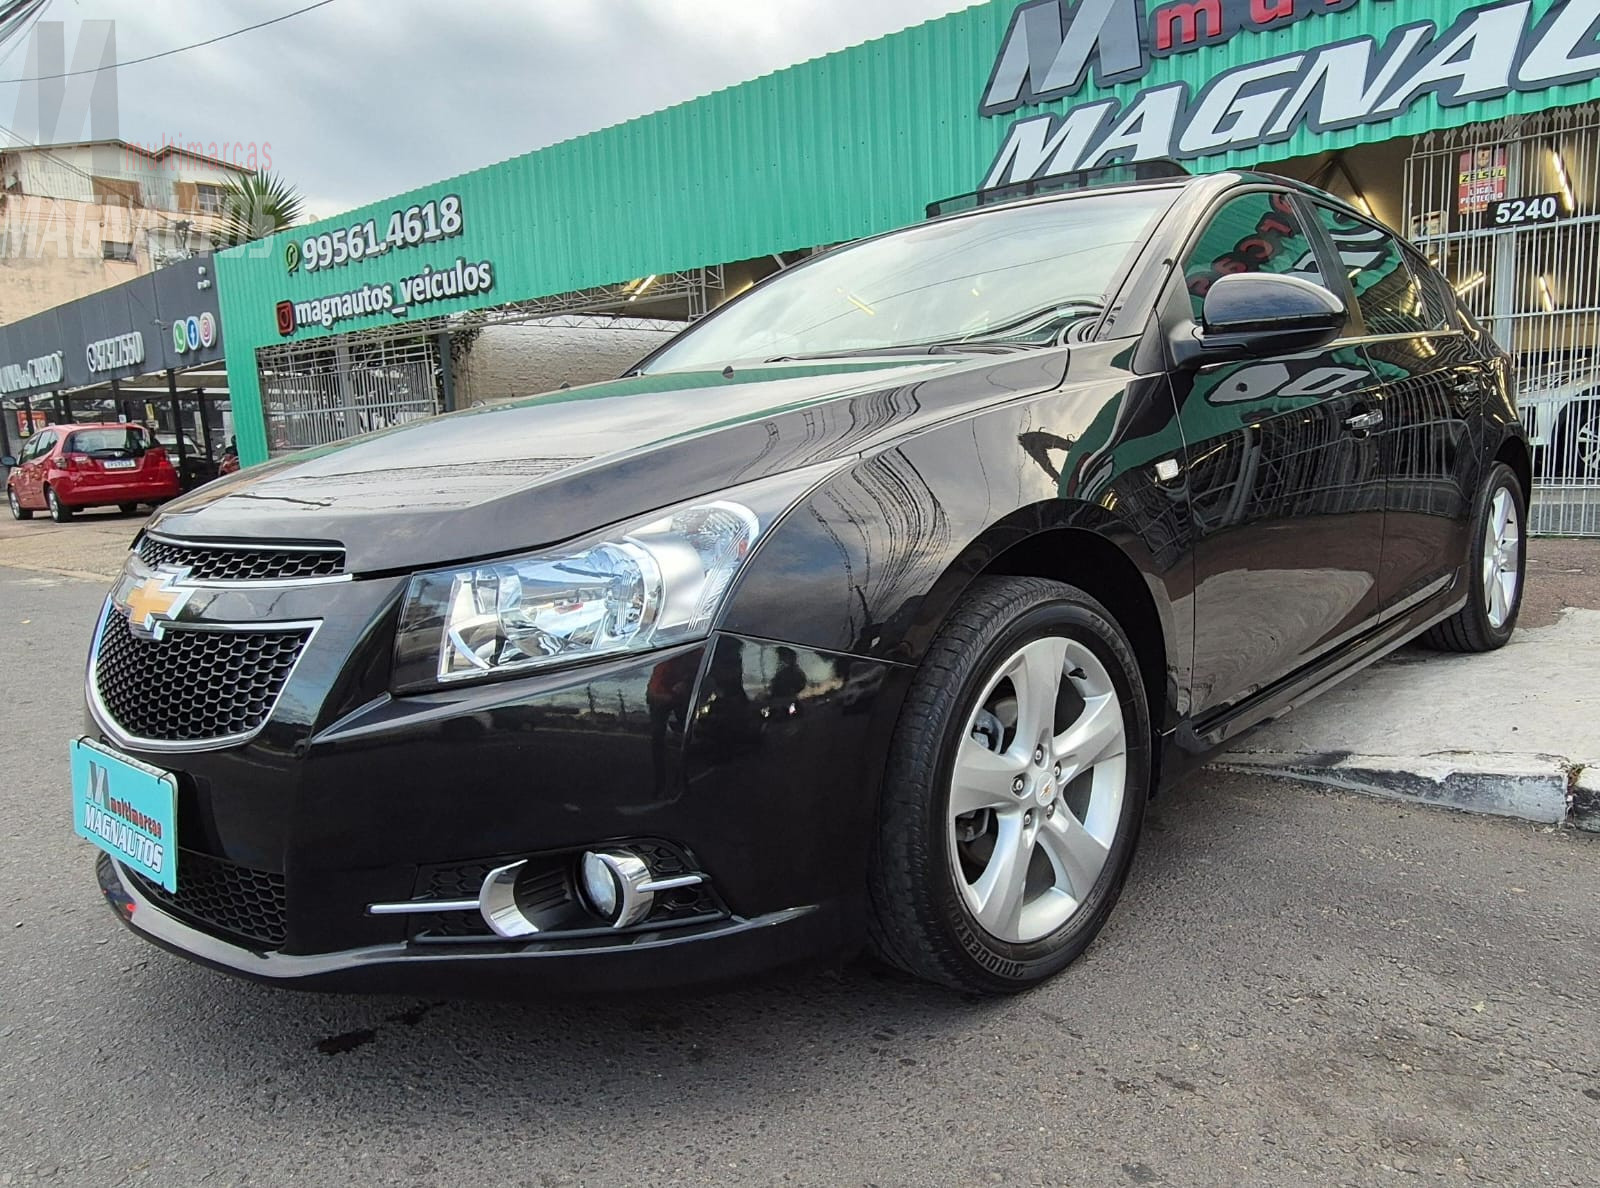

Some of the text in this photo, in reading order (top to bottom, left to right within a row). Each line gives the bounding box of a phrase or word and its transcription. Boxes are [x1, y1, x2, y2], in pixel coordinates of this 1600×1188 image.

[1156, 0, 1341, 49] mu
[302, 196, 462, 271] 99561.4618
[1495, 197, 1557, 224] 5240
[295, 259, 492, 327] magnautos_veiculos
[84, 802, 163, 873] MAGNAUTOS
